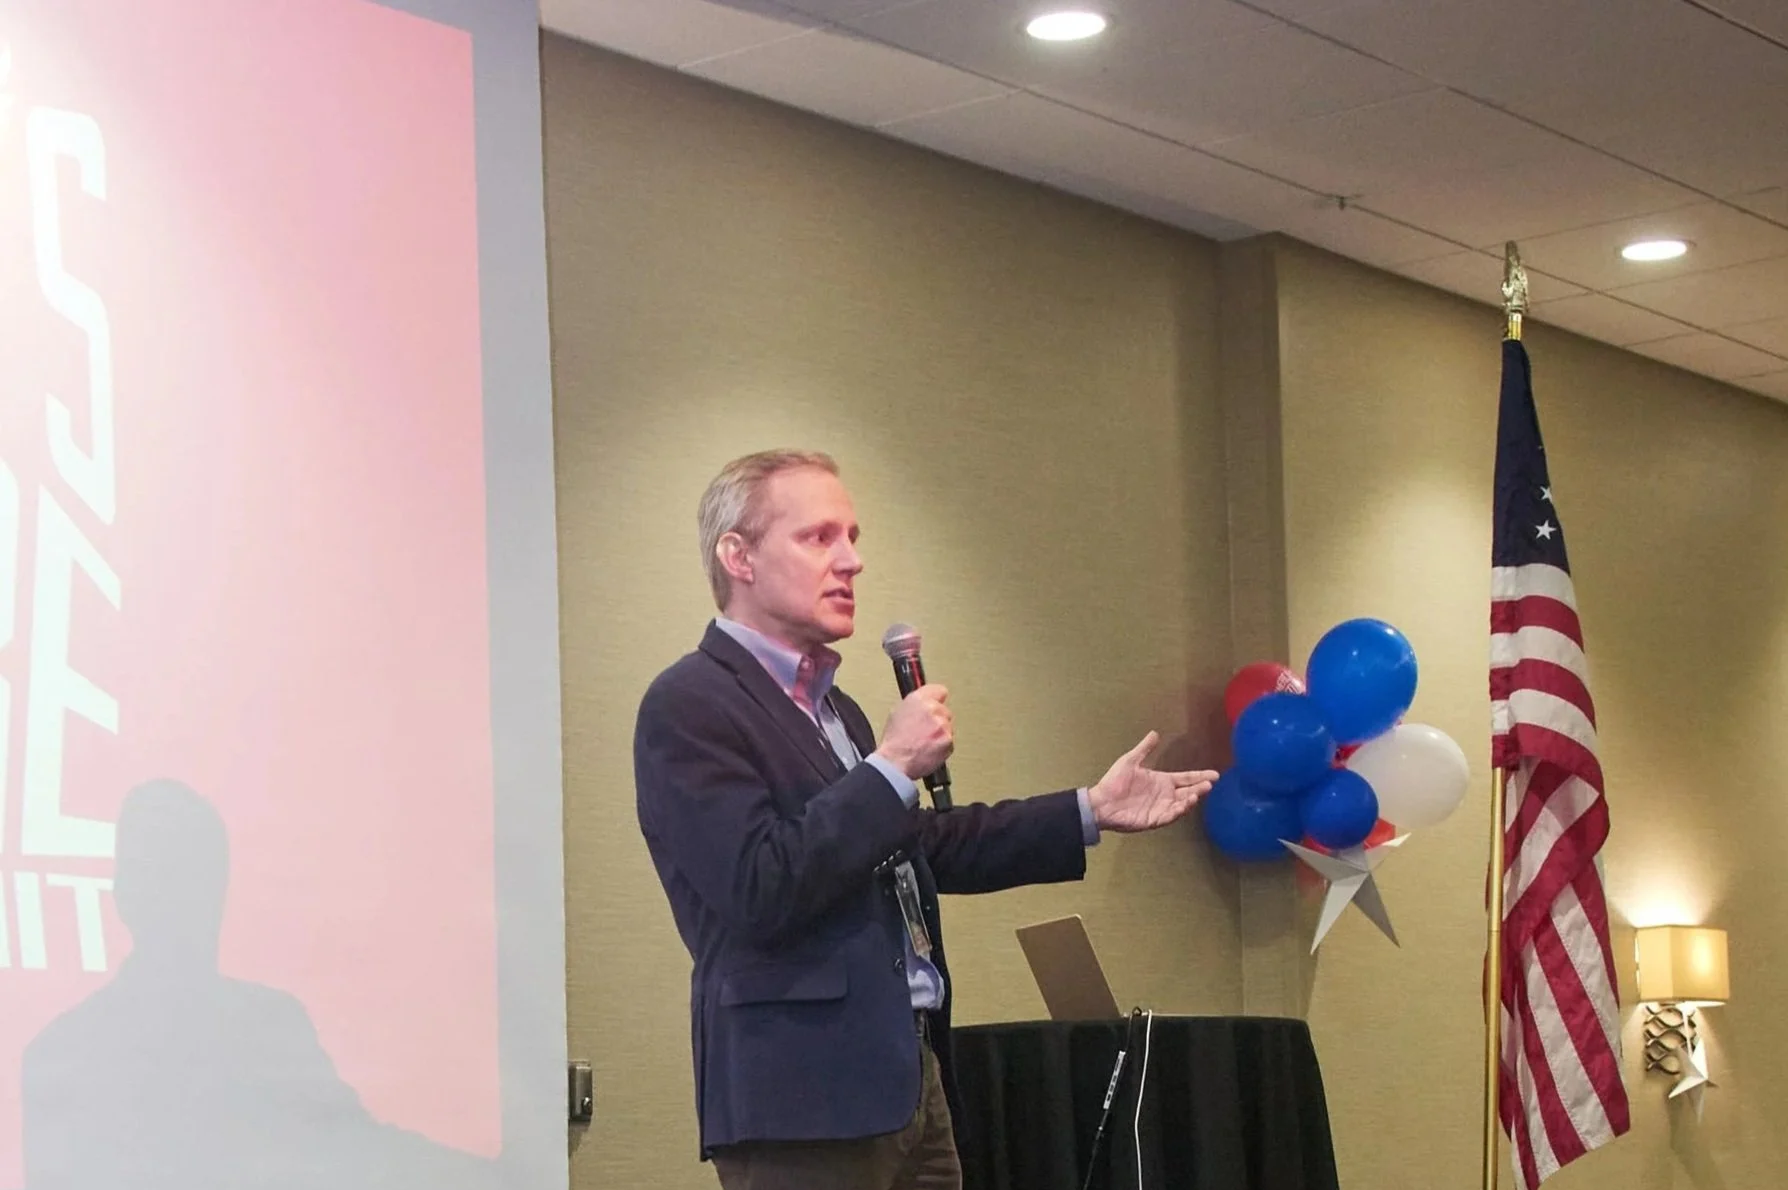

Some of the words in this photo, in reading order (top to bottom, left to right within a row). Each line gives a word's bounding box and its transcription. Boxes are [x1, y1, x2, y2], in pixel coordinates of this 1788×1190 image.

[0, 50, 116, 525] S
[0, 456, 121, 858] E
[0, 870, 114, 971] IT
